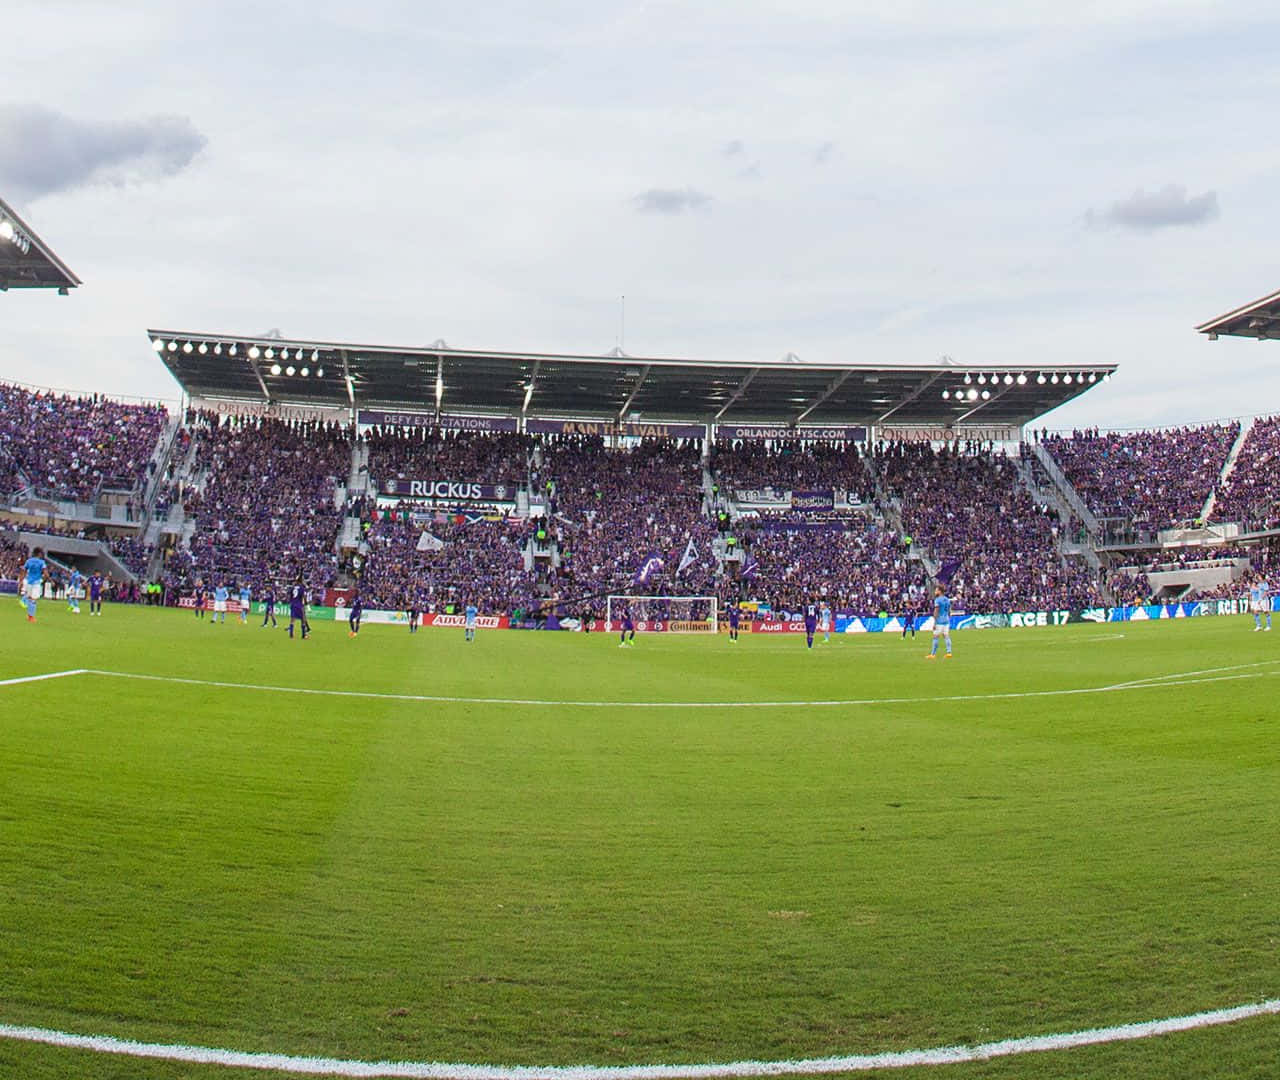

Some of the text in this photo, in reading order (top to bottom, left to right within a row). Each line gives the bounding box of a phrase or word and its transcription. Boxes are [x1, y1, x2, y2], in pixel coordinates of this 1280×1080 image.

[384, 414, 491, 428] DEFY EXPCTATIONS
[562, 422, 670, 436] MAN THE WALL
[883, 428, 954, 440] ORLANDO
[410, 481, 482, 499] RUCKUS
[258, 604, 291, 616] Pbli
[1218, 599, 1248, 616] ACE 17
[433, 614, 500, 627] ADVOARE
[1010, 611, 1069, 627] ACE 17
[670, 621, 719, 632] Continent
[760, 623, 782, 631] Audi
